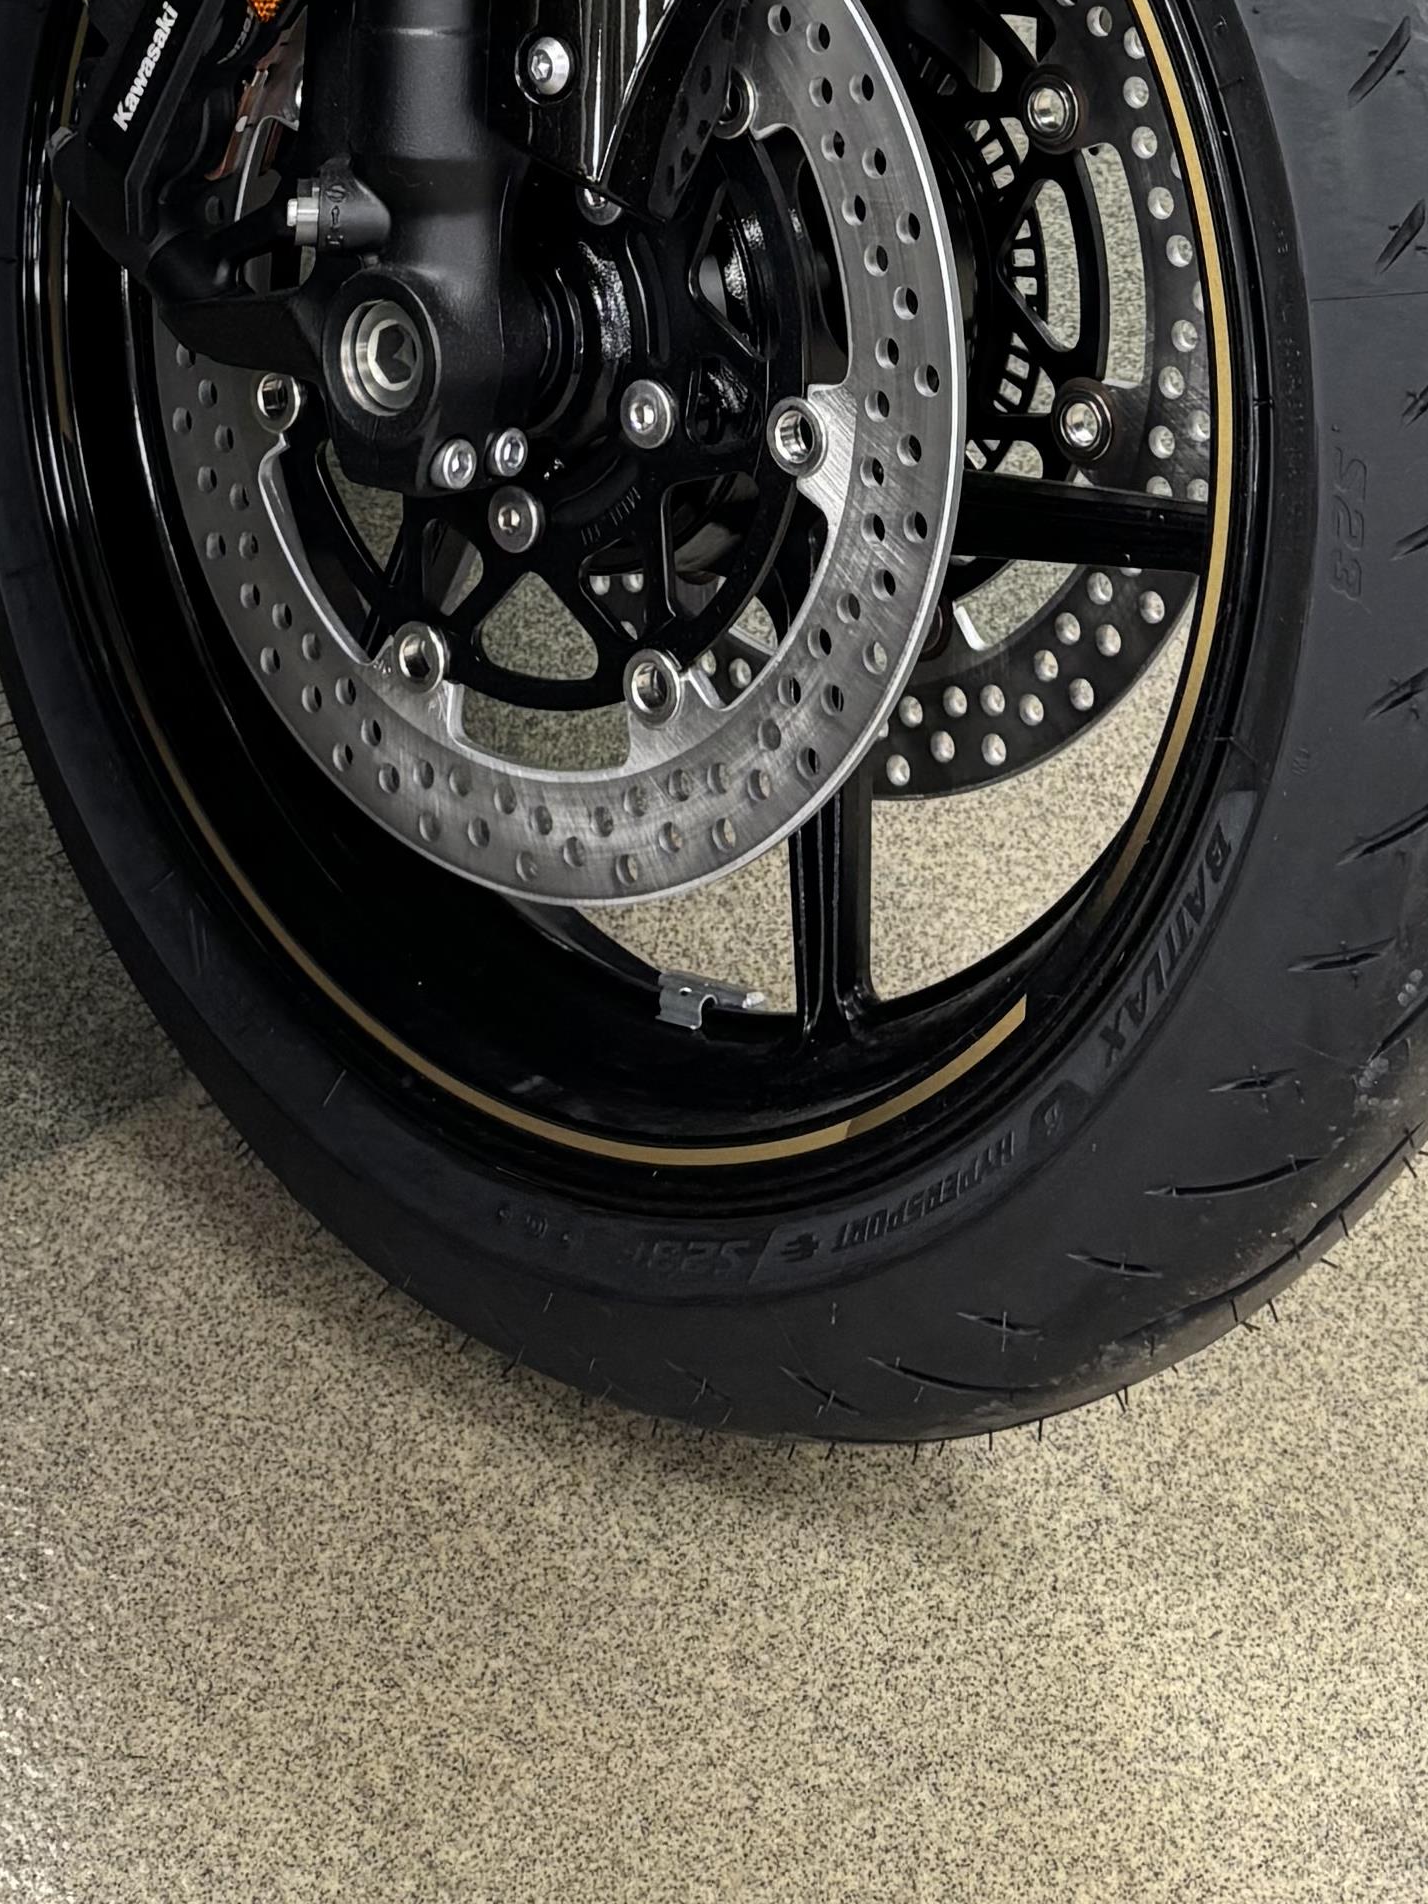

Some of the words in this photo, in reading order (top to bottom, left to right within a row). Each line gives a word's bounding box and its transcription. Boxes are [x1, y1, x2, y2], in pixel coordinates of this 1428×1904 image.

[112, 0, 179, 132] Kawasaki
[1097, 822, 1233, 1069] BATTLAX
[831, 1129, 1015, 1253] HYPERSPORT
